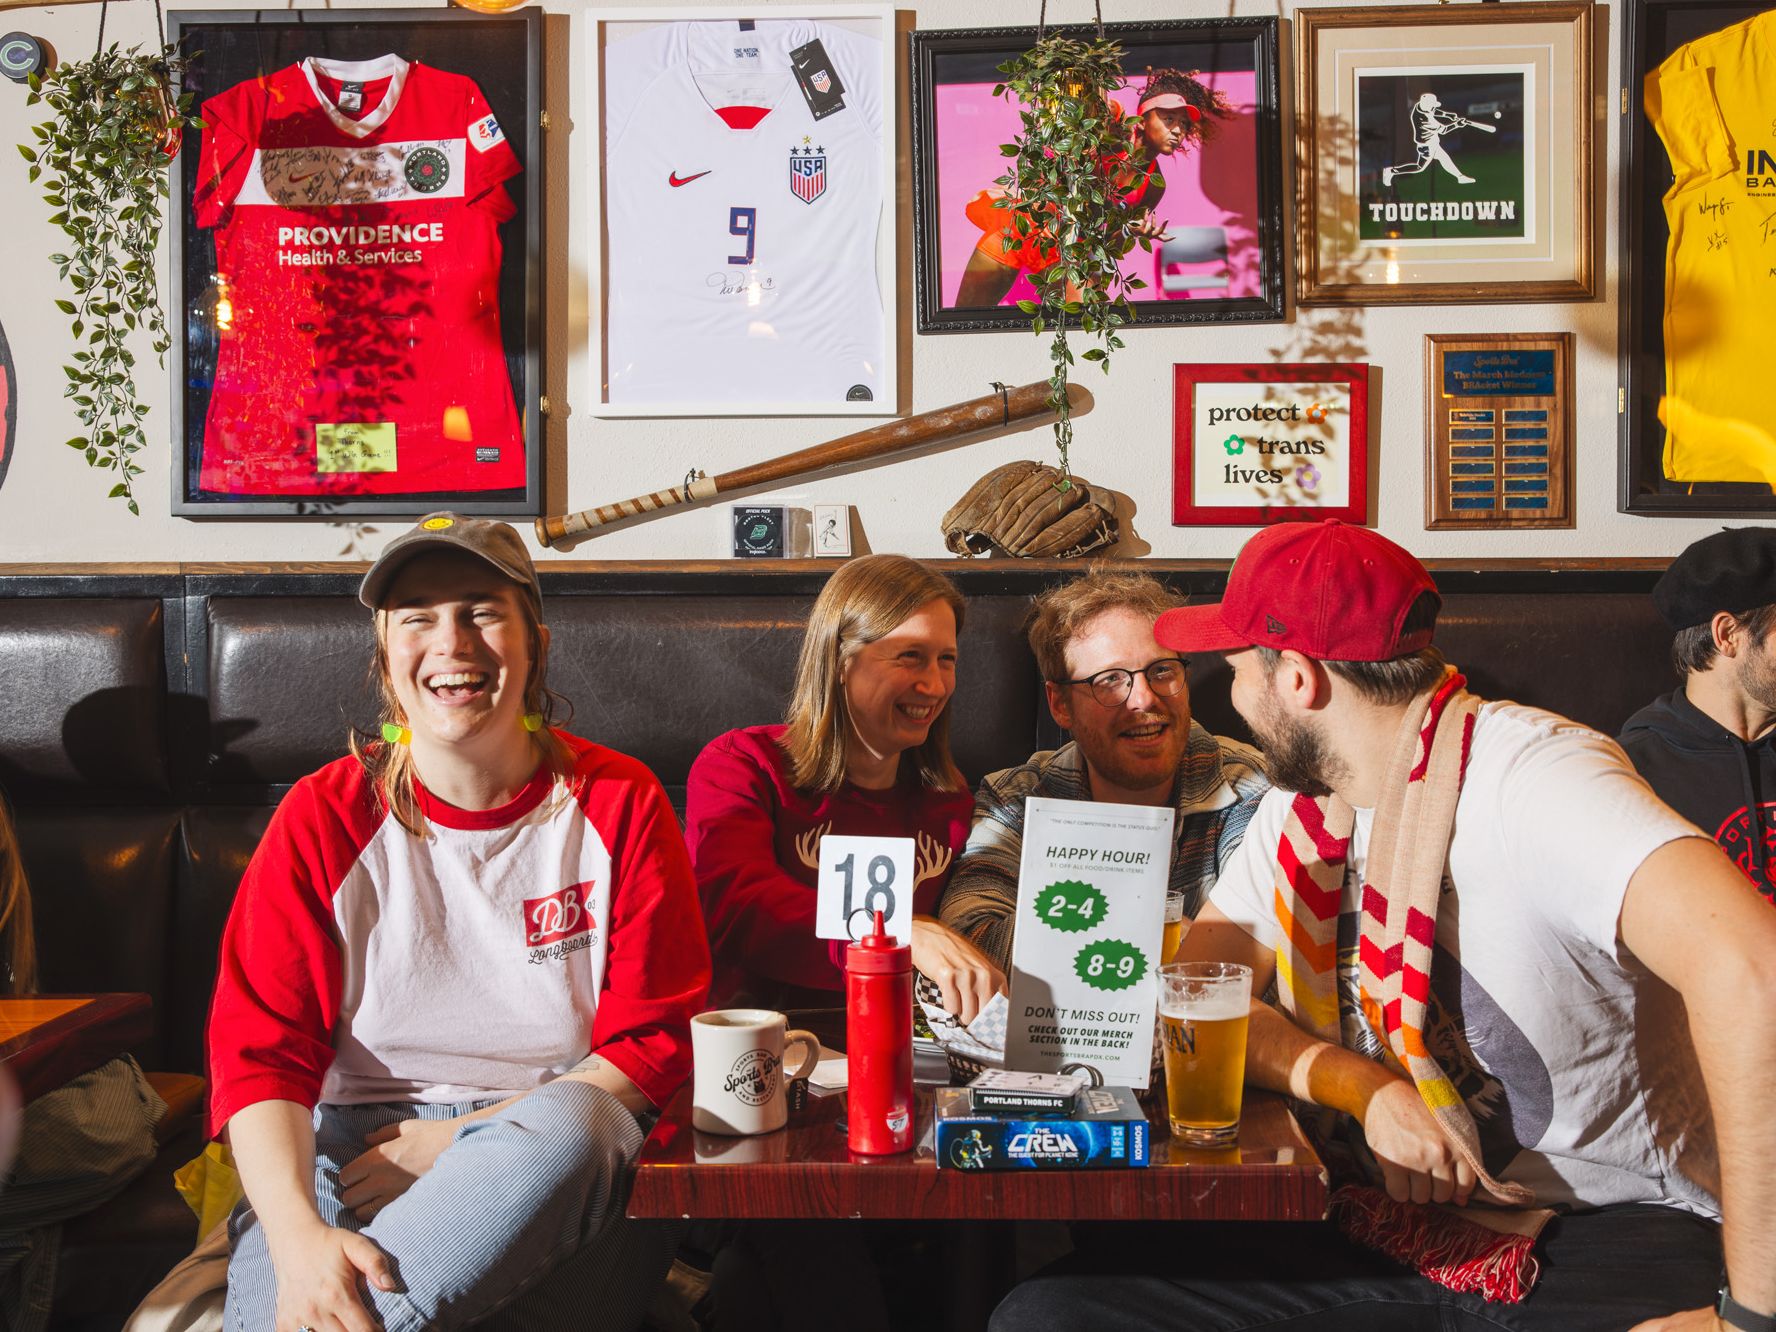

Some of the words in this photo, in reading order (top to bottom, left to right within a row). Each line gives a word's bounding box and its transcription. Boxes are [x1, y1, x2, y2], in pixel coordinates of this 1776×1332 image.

[812, 71, 827, 83] USA
[409, 150, 446, 165] PORTLAND
[793, 160, 823, 176] USA
[1369, 201, 1515, 222] TOUCHDOWN
[278, 222, 444, 246] PROVIDENCE
[728, 207, 756, 265] 9
[278, 248, 333, 266] Health
[337, 249, 350, 265] &
[354, 247, 422, 264] Services
[1453, 371, 1470, 380] The
[1472, 370, 1503, 379] March
[1208, 403, 1301, 426] protect
[1257, 436, 1326, 455] trans
[1224, 463, 1284, 484] lives
[1046, 846, 1098, 861] HAPPY
[1102, 850, 1151, 865] HOUR!
[1085, 865, 1125, 873] FOOD/DRINK
[835, 853, 896, 924] 18
[587, 899, 596, 910] 03
[1047, 895, 1095, 919] 2-4
[1087, 954, 1135, 978] 8-9
[1024, 1006, 1068, 1019] DON'T
[1070, 1009, 1104, 1022] MISS
[1108, 1012, 1140, 1024] OUT!
[1028, 1025, 1057, 1035] CHECK
[1060, 1027, 1078, 1036] OUT
[1080, 1028, 1099, 1037] OUR
[1101, 1029, 1133, 1040] MERCH
[1029, 1035, 1067, 1045] SECTION
[1069, 1037, 1080, 1046] IN
[1082, 1038, 1099, 1047] THE
[1101, 1039, 1130, 1049] BACK!
[1040, 1050, 1121, 1061] THESPORTSBRAPDX.COM
[724, 1067, 762, 1092] Sports
[983, 1096, 1022, 1106] PORTLAND
[1023, 1098, 1052, 1107] THORNS
[1053, 1099, 1063, 1108] FC
[1007, 1133, 1079, 1153] CREW
